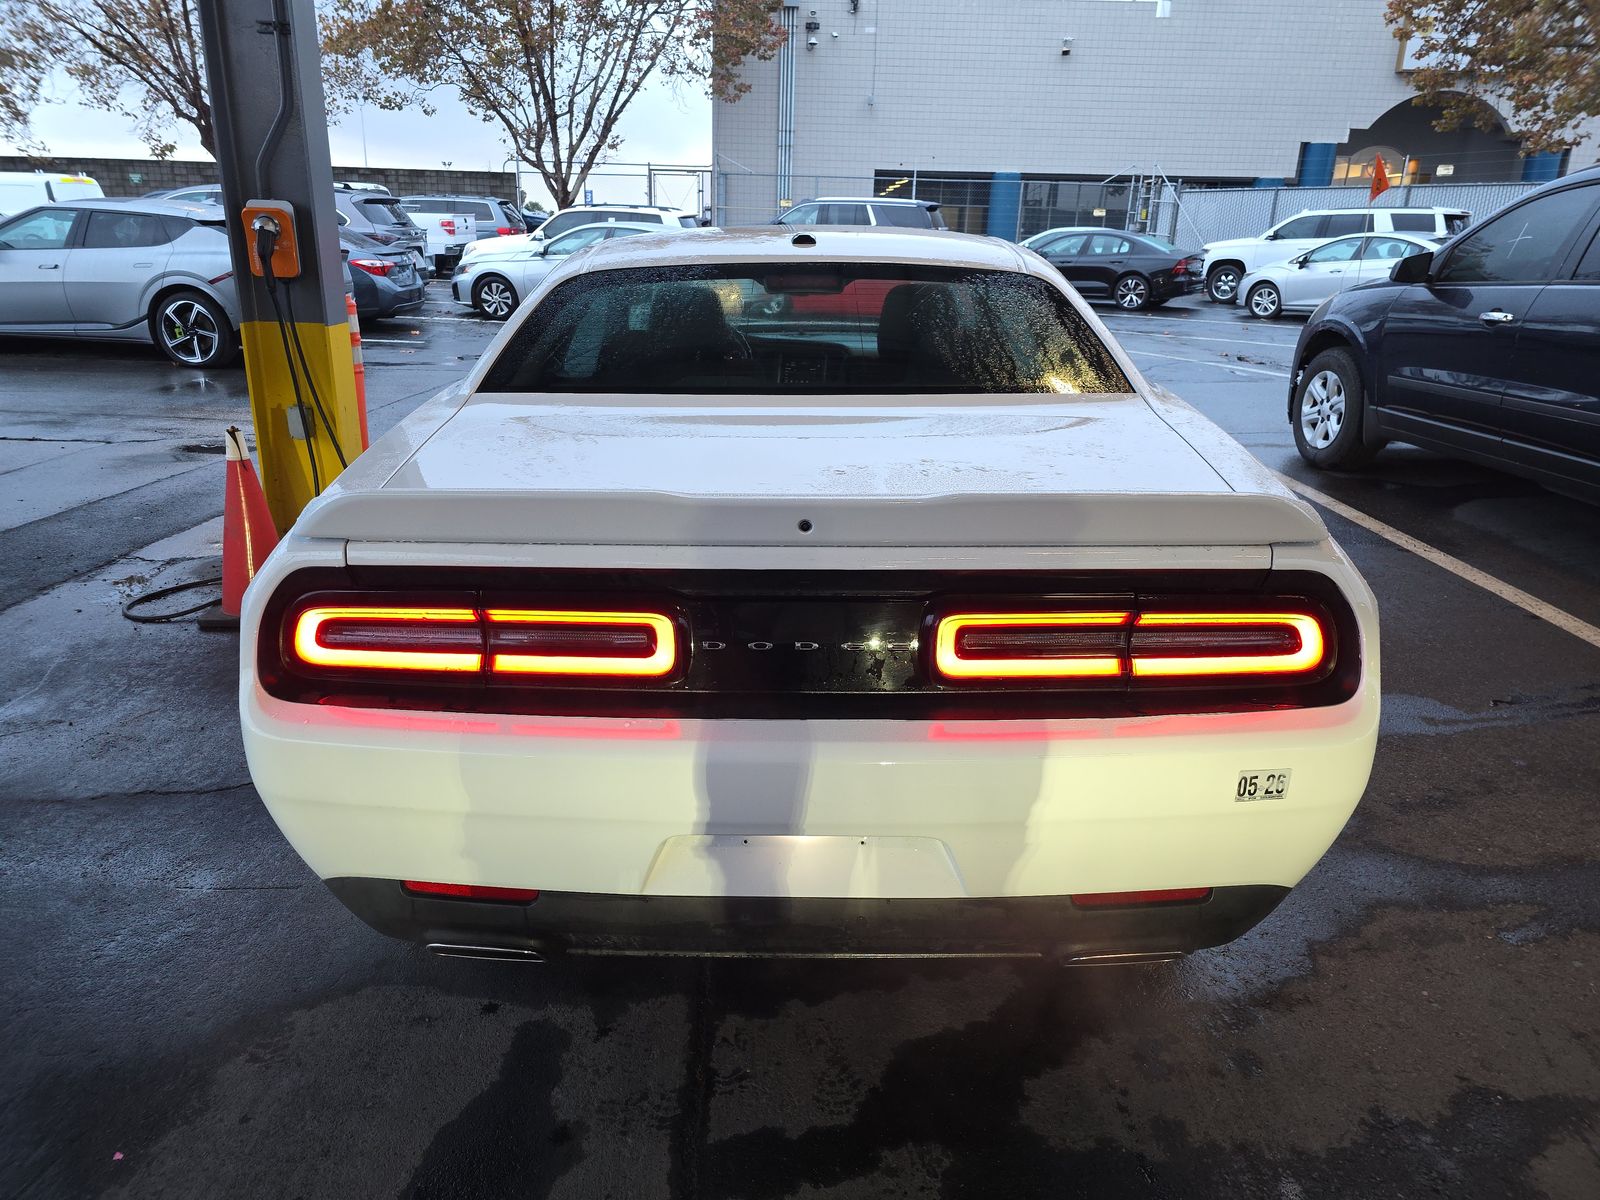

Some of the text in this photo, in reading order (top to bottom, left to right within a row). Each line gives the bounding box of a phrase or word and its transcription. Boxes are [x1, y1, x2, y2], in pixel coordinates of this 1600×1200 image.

[585, 192, 592, 202] 3
[1236, 773, 1287, 797] 05 26
